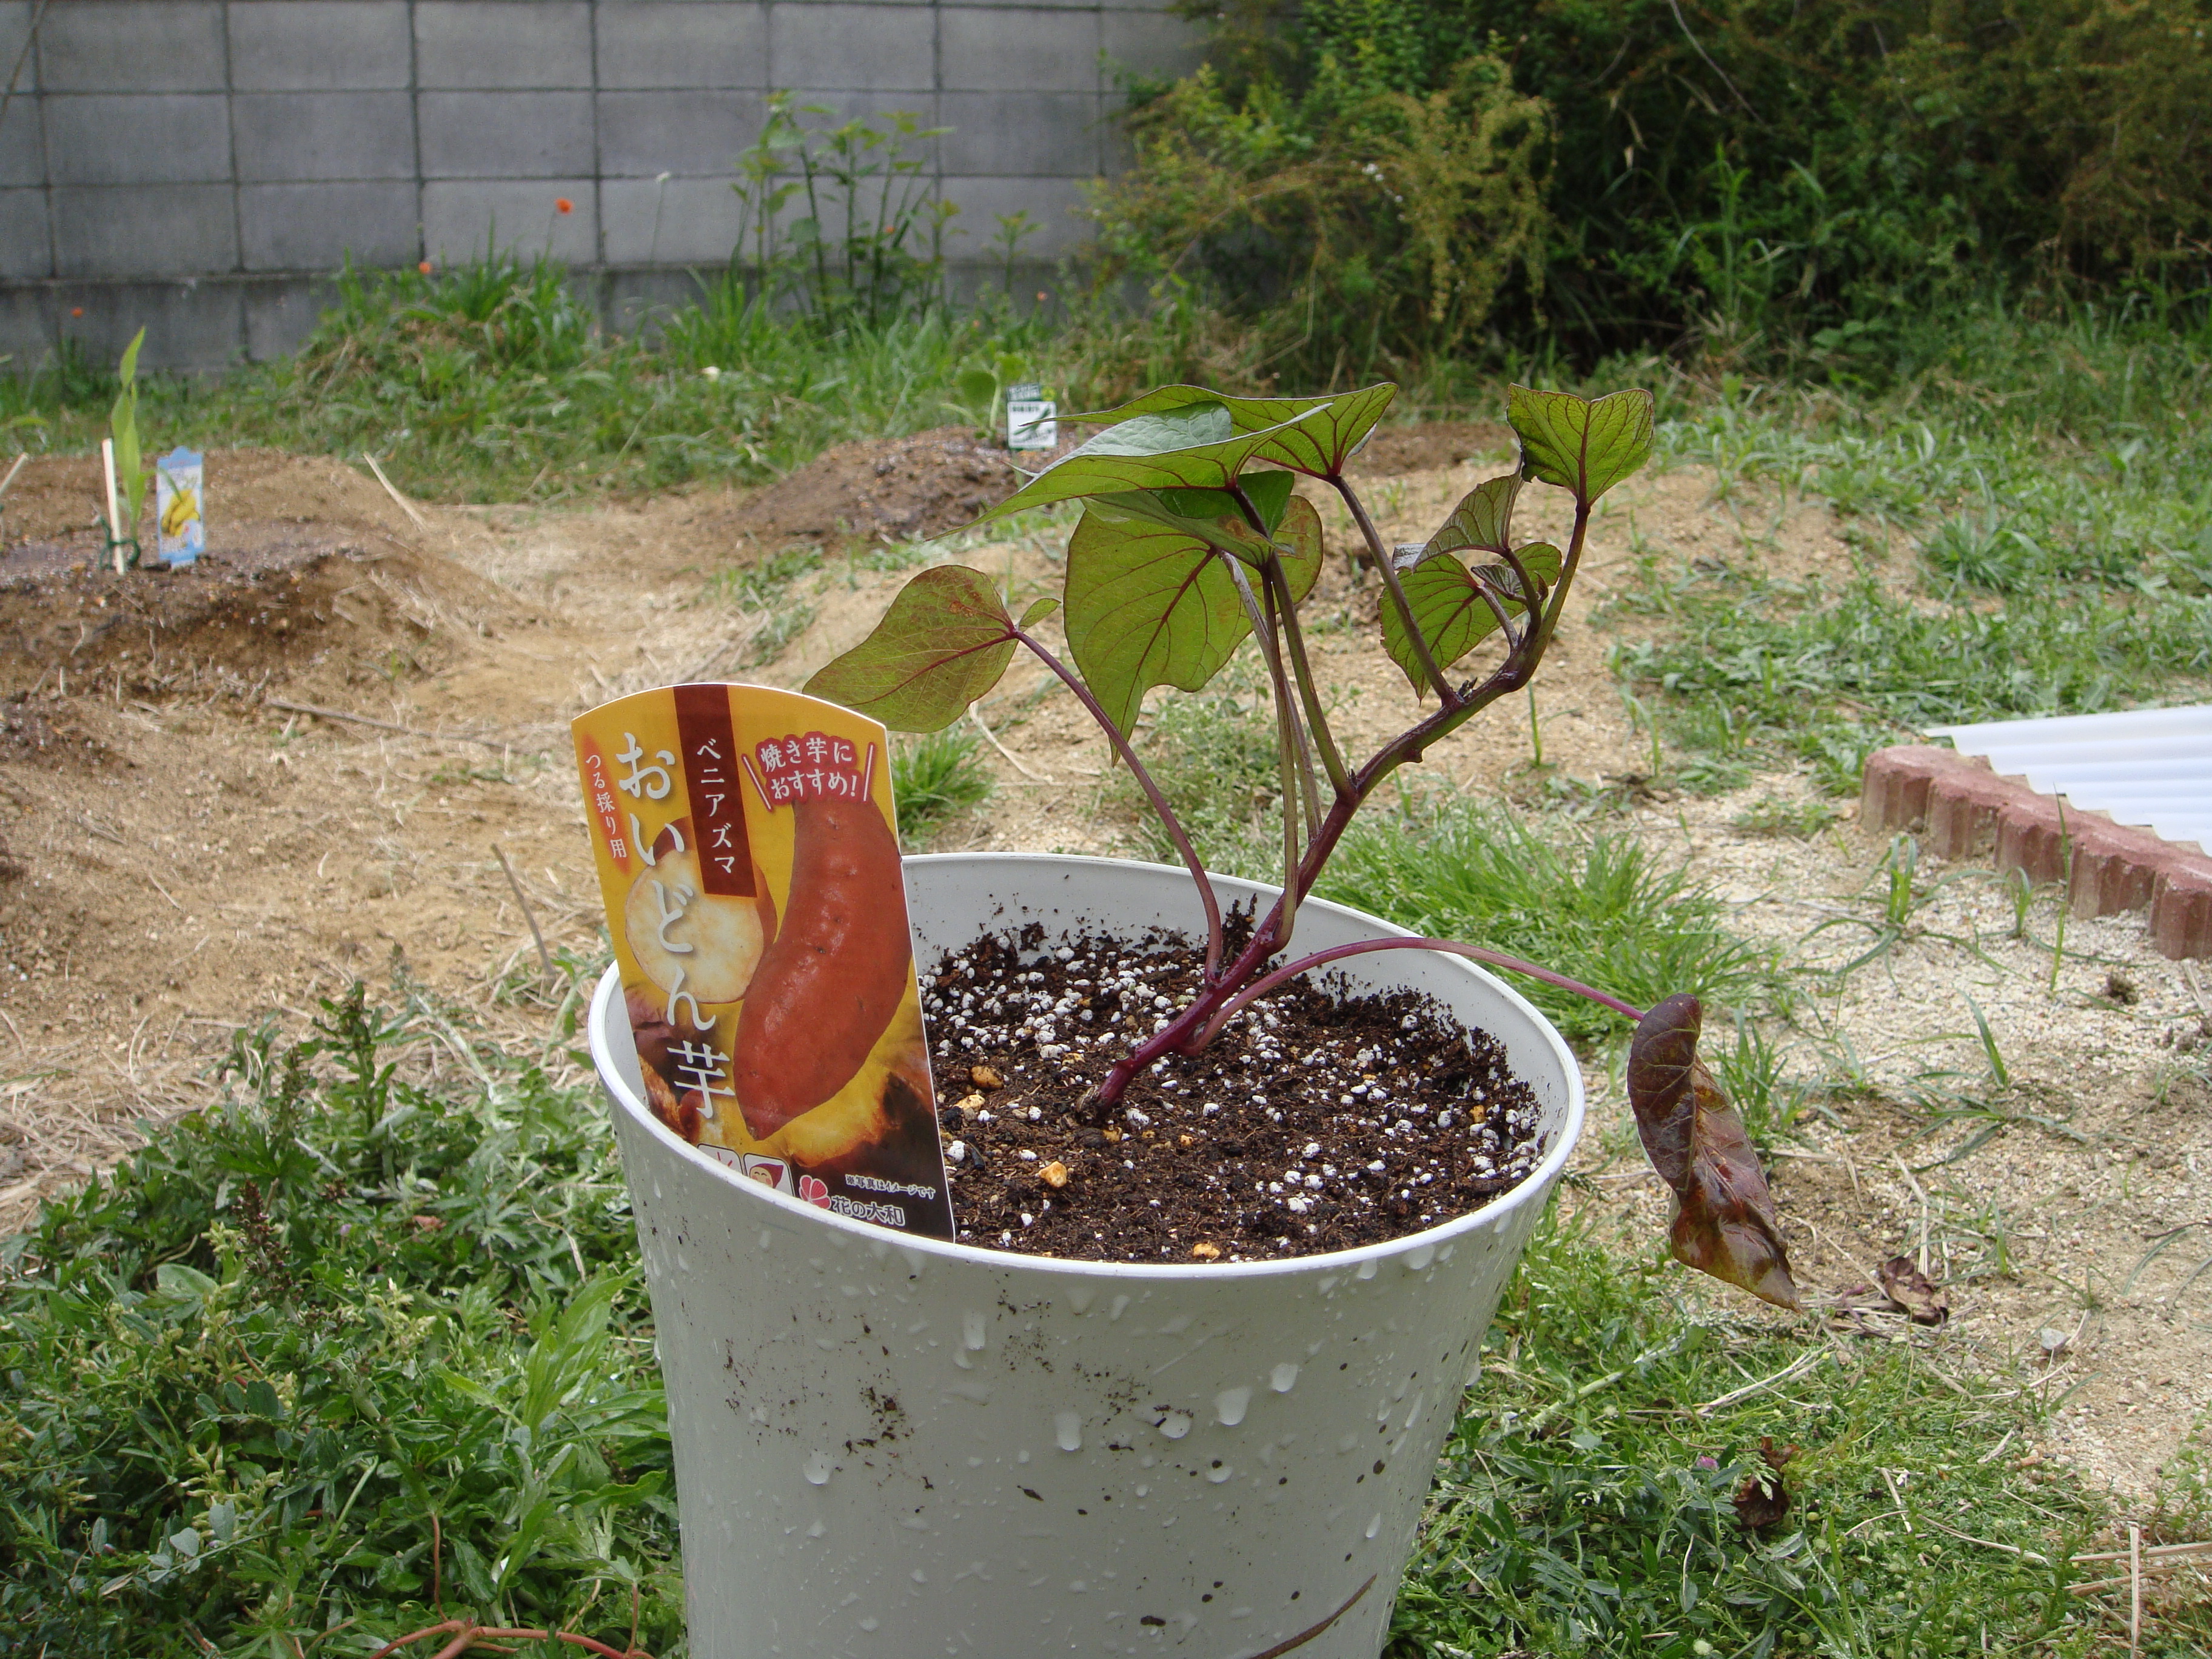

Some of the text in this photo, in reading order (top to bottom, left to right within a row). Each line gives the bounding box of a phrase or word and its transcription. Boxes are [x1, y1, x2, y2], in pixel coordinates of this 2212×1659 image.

[760, 737, 853, 773] 焼き芋に
[771, 768, 857, 800] おすすめ!
[586, 754, 628, 859] つる採り用
[697, 738, 735, 873] ベニアズマ
[615, 732, 736, 1119] おいどん芋
[831, 1195, 906, 1227] 花の大和
